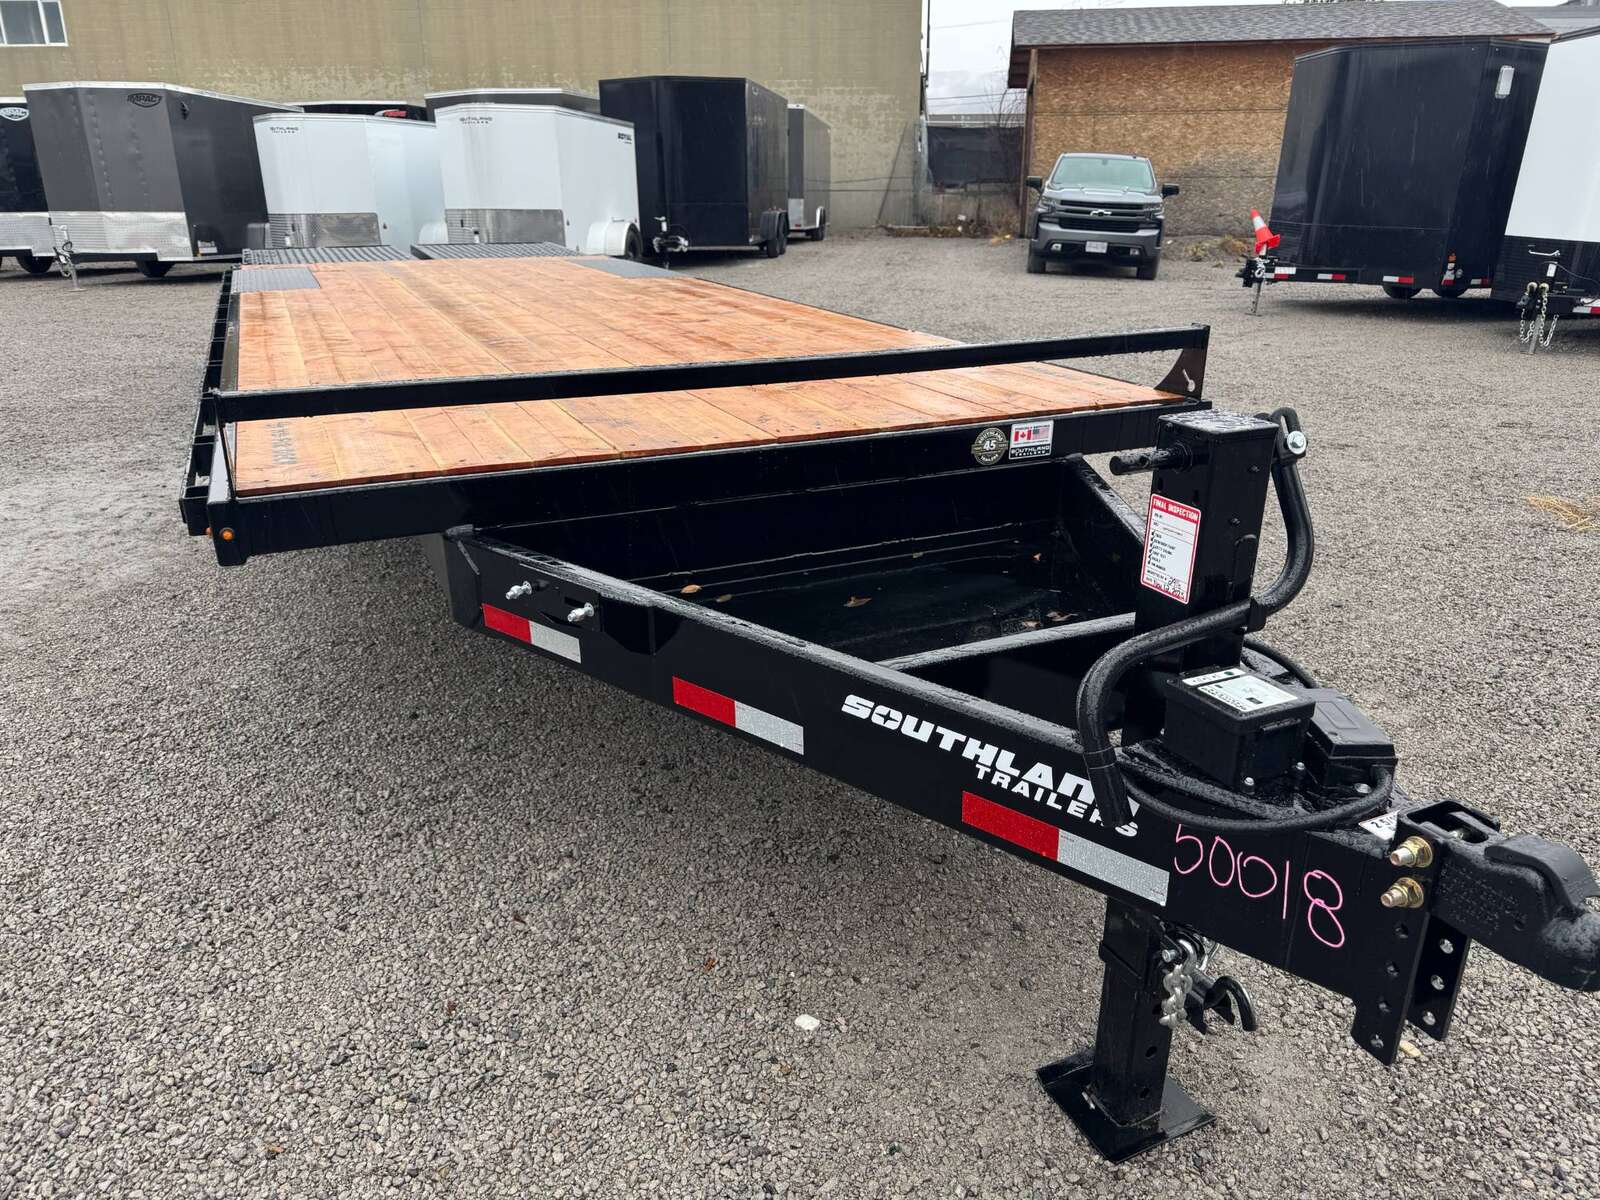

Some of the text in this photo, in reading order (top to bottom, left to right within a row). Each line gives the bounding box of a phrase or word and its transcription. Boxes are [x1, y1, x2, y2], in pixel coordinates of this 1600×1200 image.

[983, 440, 997, 451] 45
[1011, 445, 1051, 454] SOUTHLAND
[1153, 499, 1199, 521] FINAL INSPECTION
[841, 694, 1140, 817] SOUTHLAN
[1174, 823, 1345, 948] 50018
